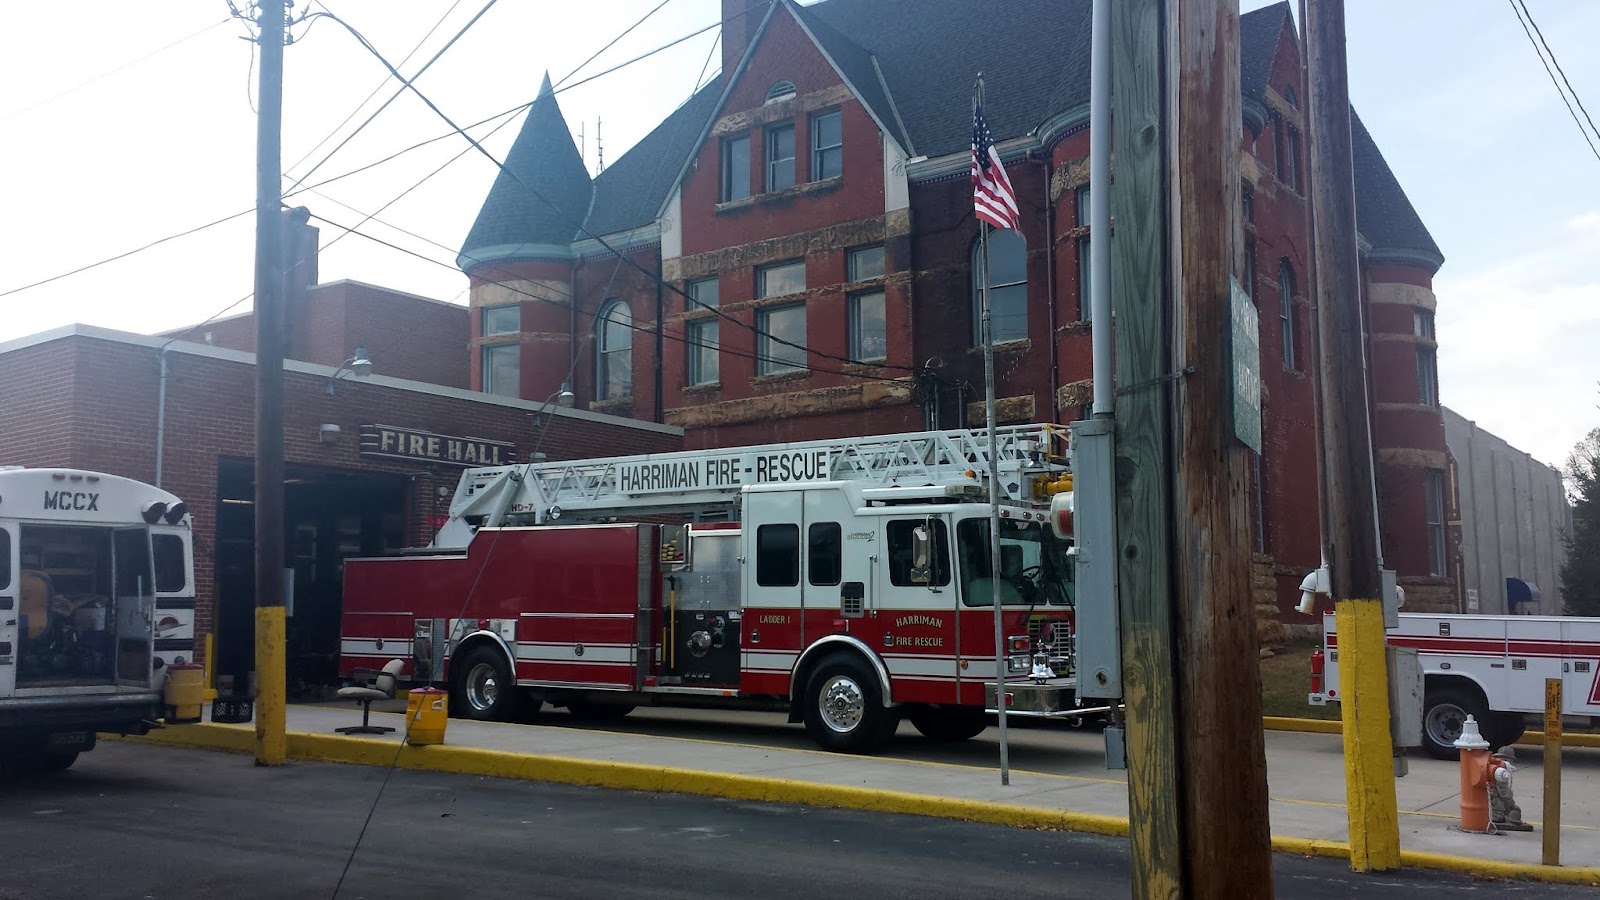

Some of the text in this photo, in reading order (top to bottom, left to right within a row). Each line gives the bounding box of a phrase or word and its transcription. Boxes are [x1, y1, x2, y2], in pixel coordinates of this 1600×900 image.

[381, 430, 504, 465] FIRE HALL
[621, 461, 699, 491] HARRIMAN
[706, 458, 741, 486] FIRE
[757, 451, 827, 483] RESCUE
[44, 490, 100, 511] MCCX
[511, 503, 534, 512] HD-7
[759, 614, 785, 624] LADDER
[895, 615, 943, 628] HARRIMAN
[896, 636, 943, 647] FIRE RESCUE
